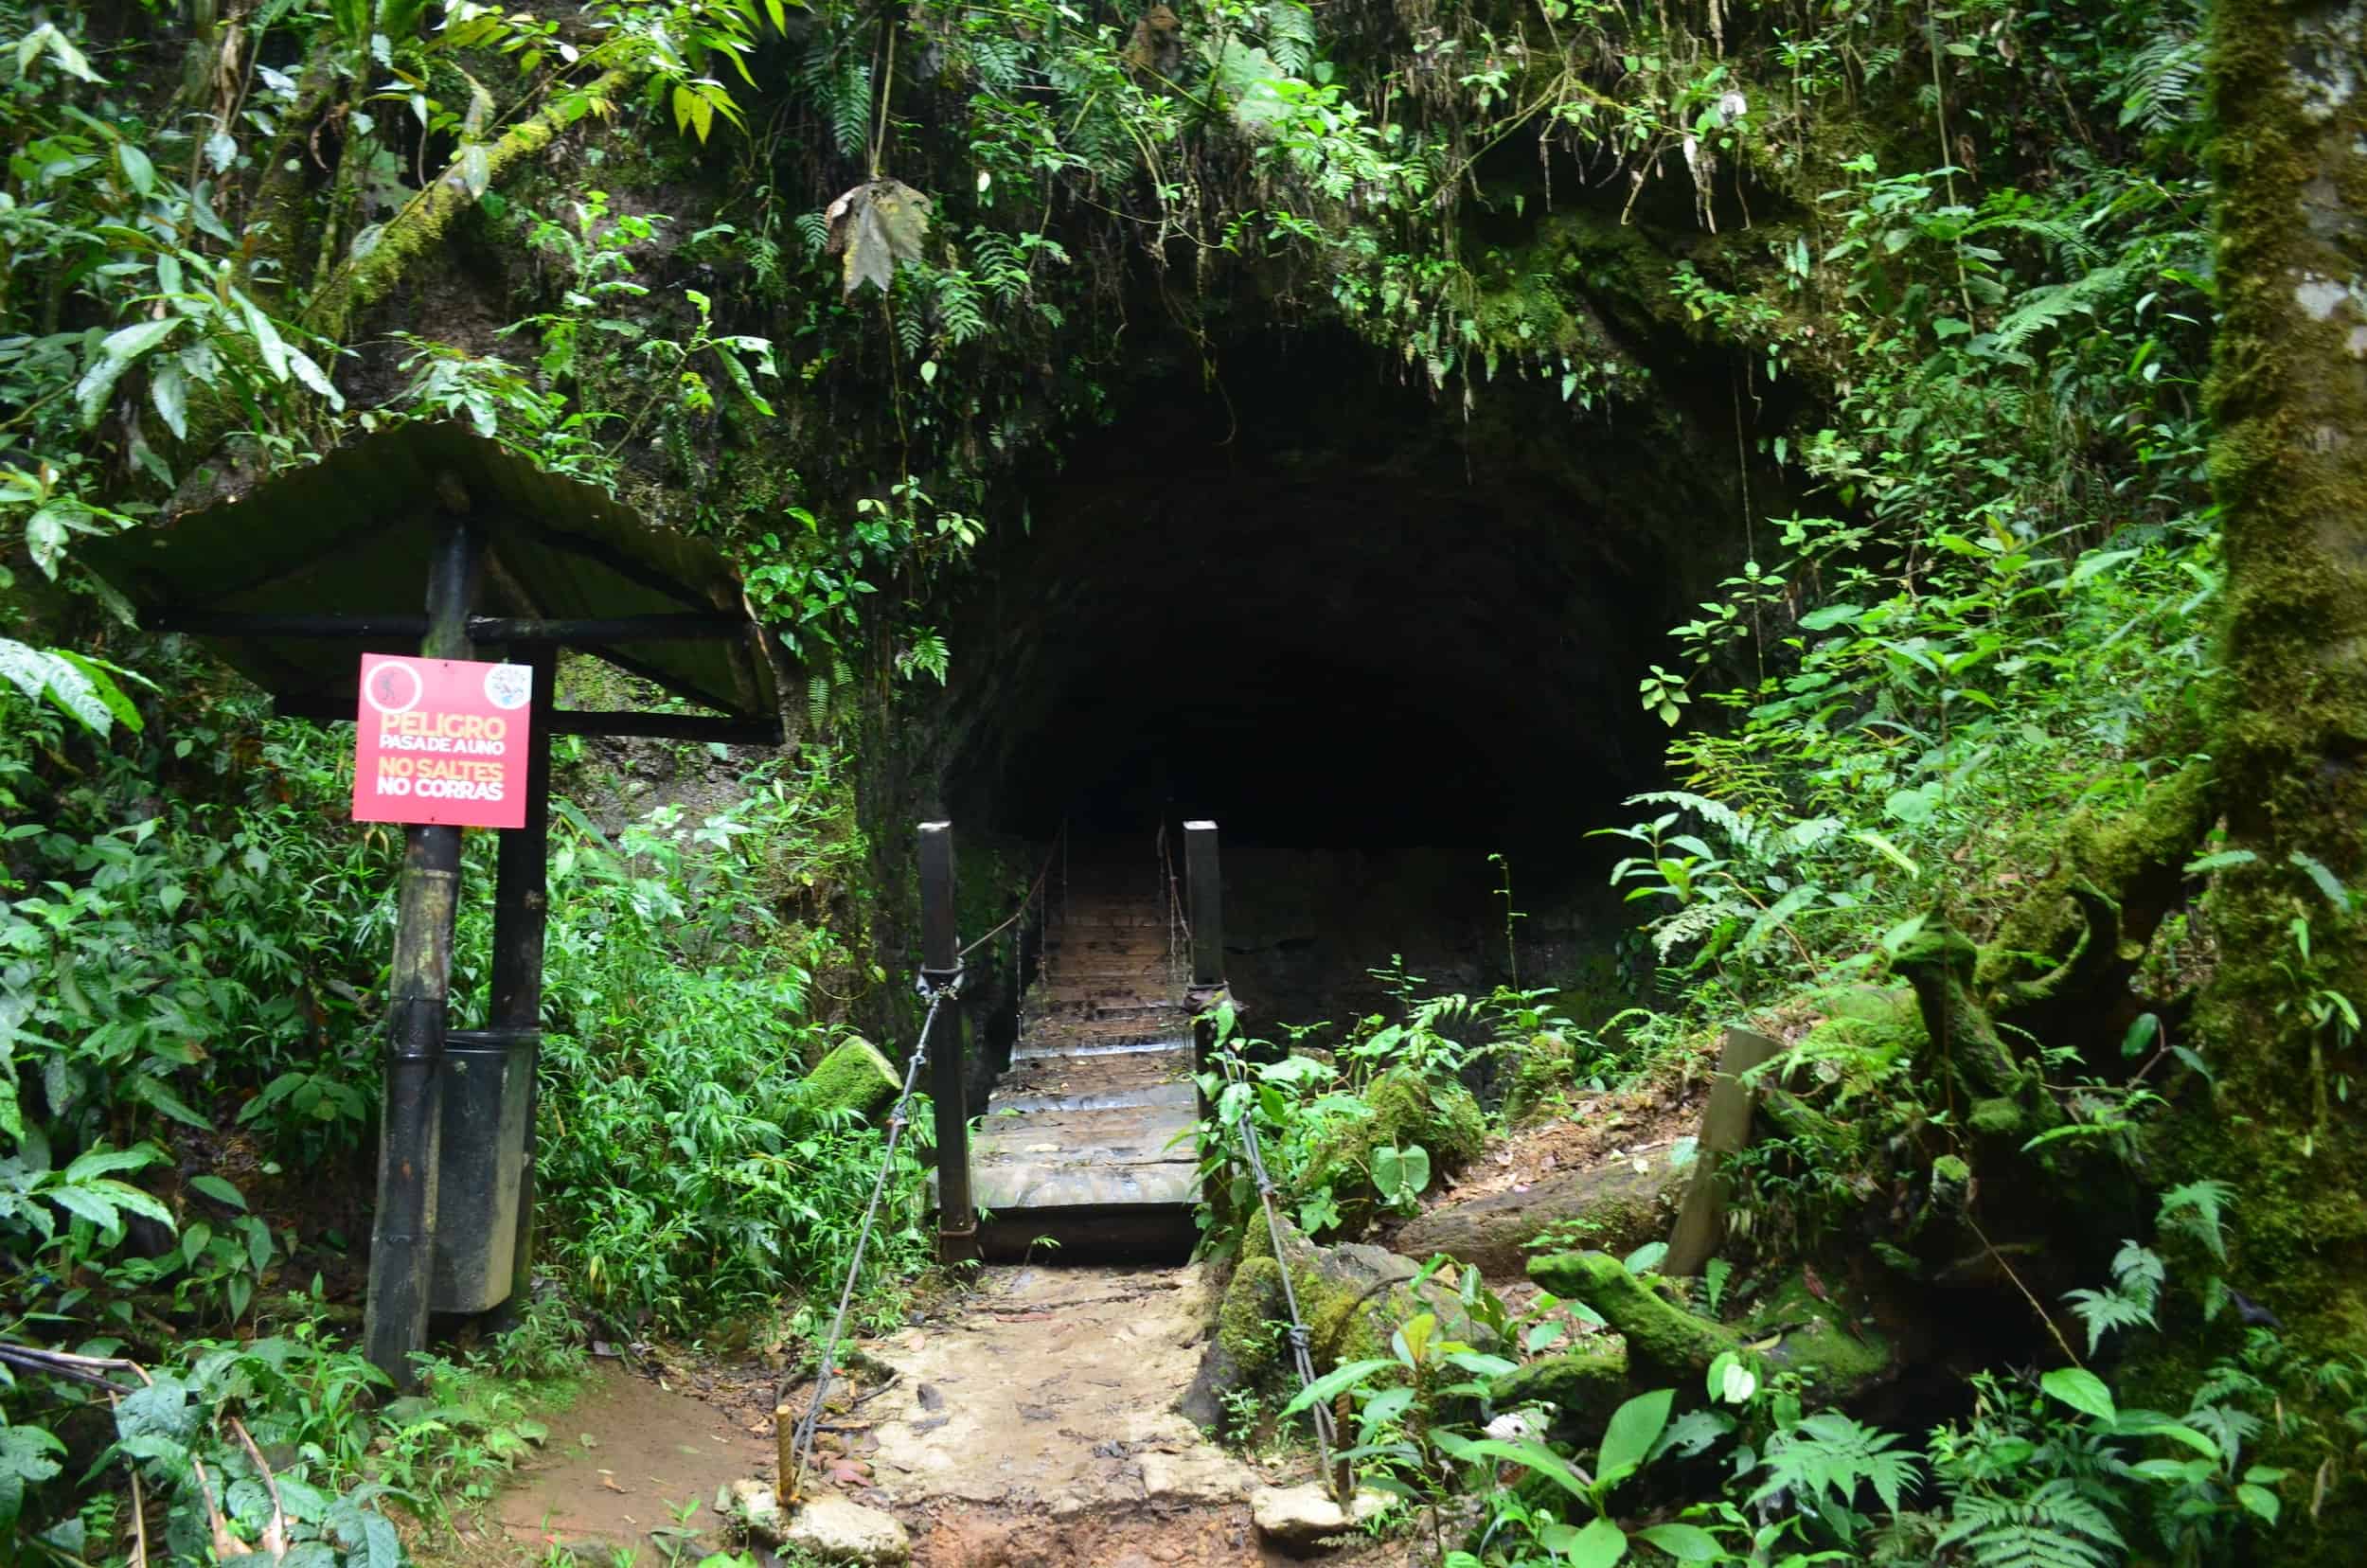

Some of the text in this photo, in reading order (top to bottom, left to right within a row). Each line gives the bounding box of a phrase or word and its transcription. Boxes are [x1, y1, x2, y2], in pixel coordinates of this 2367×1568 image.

[382, 711, 506, 740] PELIGRO
[379, 734, 505, 756] PASA DE A UNO
[379, 757, 503, 782] NO SALTES
[376, 777, 504, 801] NO CORRAS
